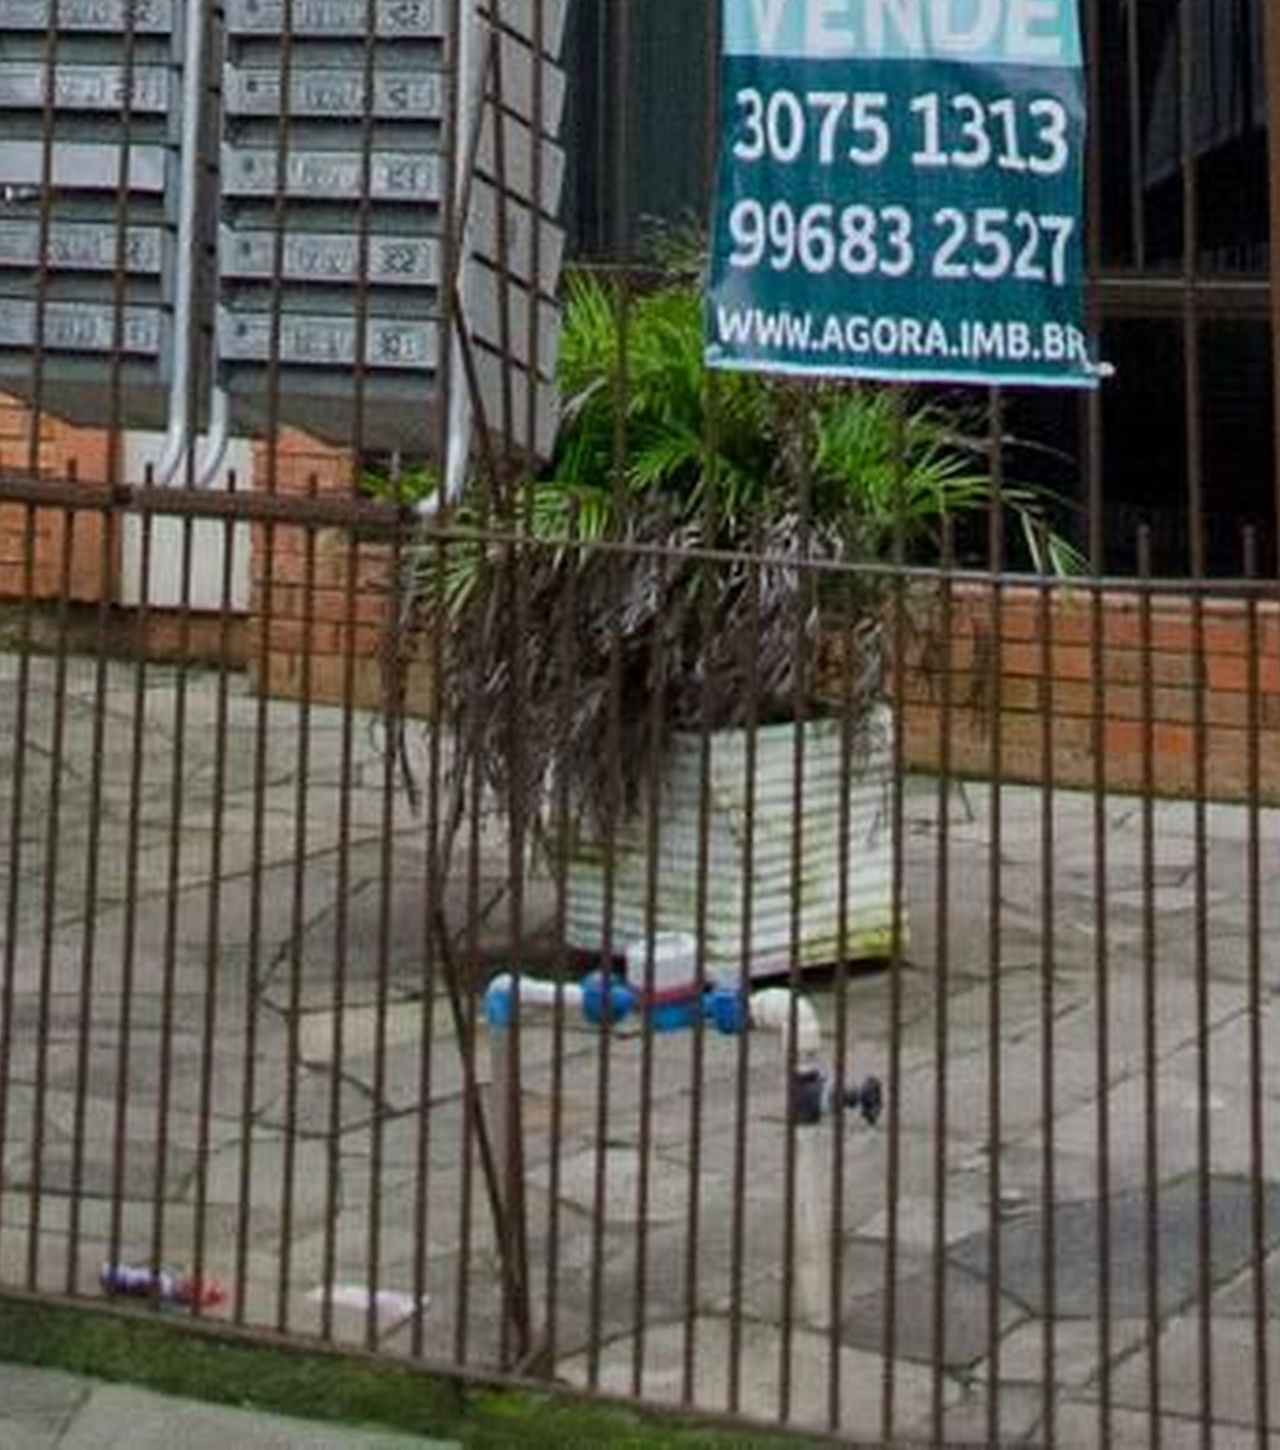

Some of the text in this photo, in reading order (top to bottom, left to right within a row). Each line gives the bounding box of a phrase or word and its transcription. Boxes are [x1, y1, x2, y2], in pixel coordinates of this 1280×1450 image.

[732, 87, 1070, 175] 3075 1313
[728, 198, 1075, 286] 99683 2527
[717, 306, 1087, 361] WWW.AGORA.IMB.BR
